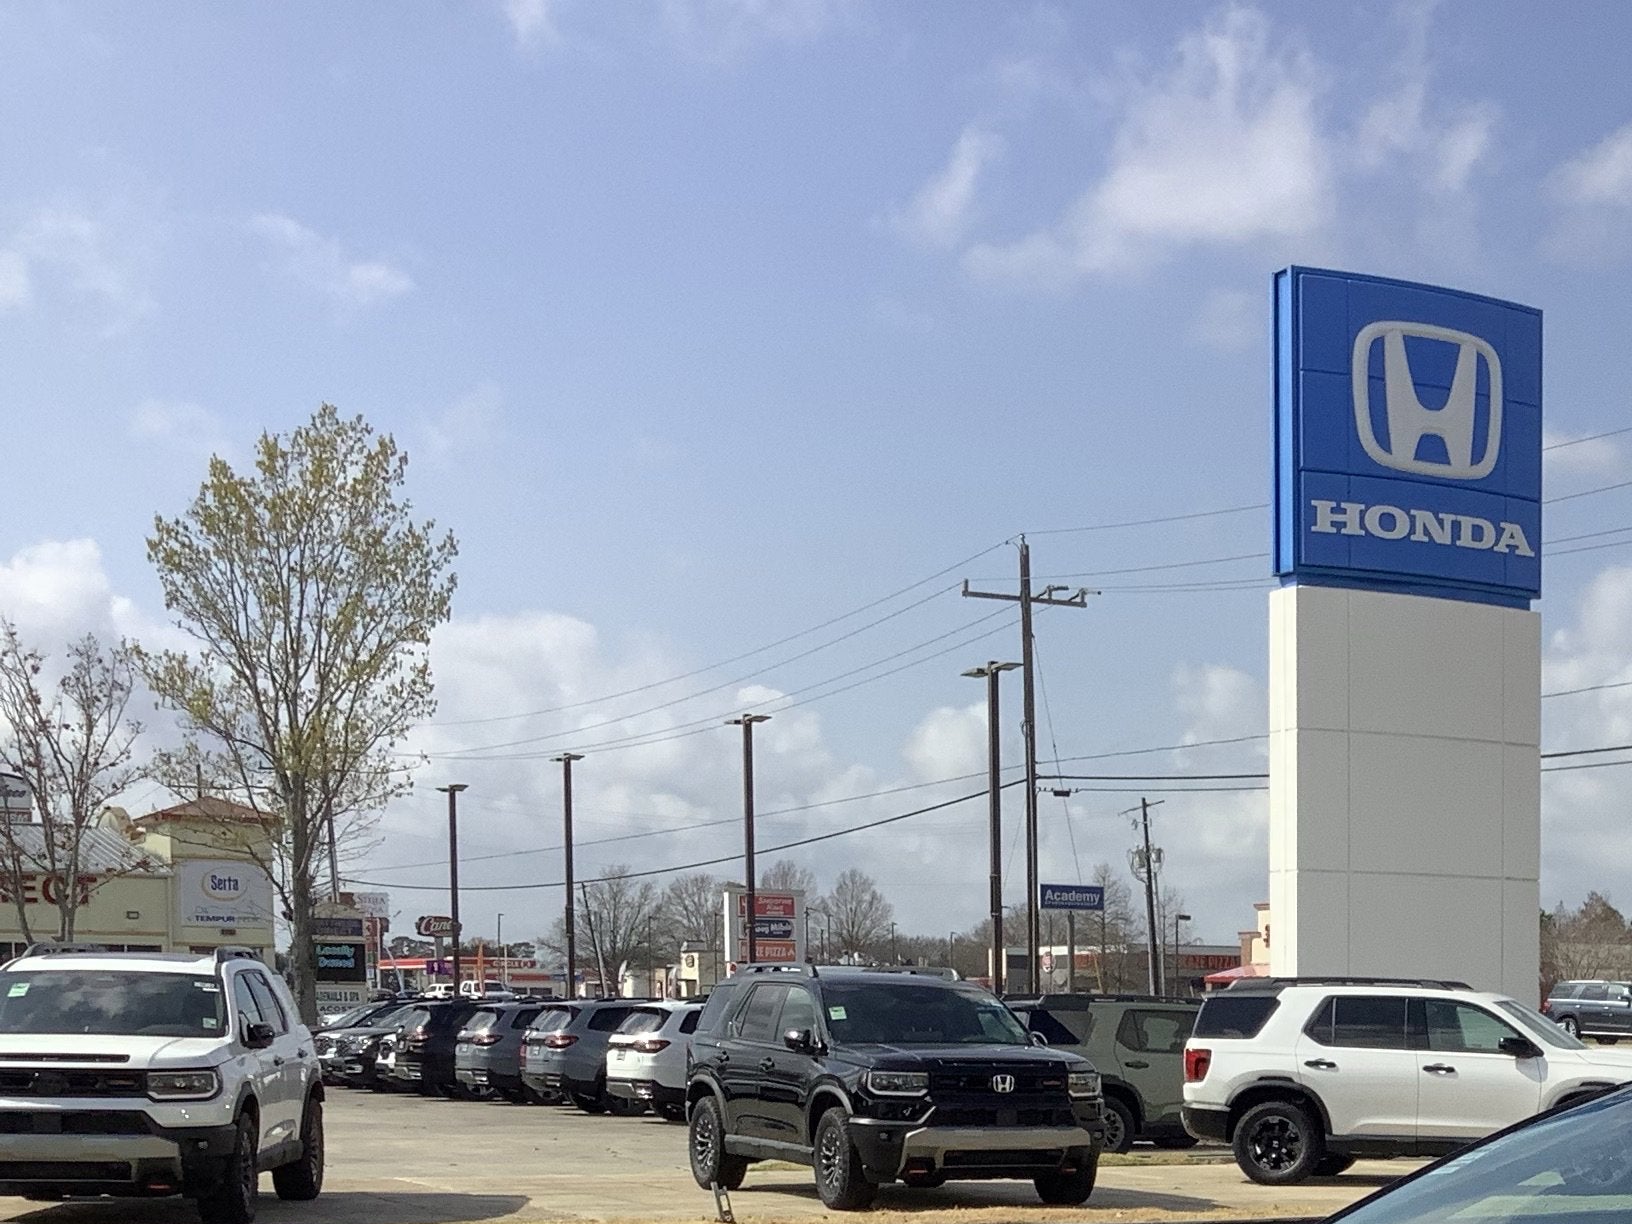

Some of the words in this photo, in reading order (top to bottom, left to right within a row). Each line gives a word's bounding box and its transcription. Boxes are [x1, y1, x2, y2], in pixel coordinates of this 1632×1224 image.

[1310, 499, 1536, 558] HONDA
[210, 874, 239, 891] Serta
[1044, 889, 1100, 905] Academy
[420, 917, 452, 934] Cane
